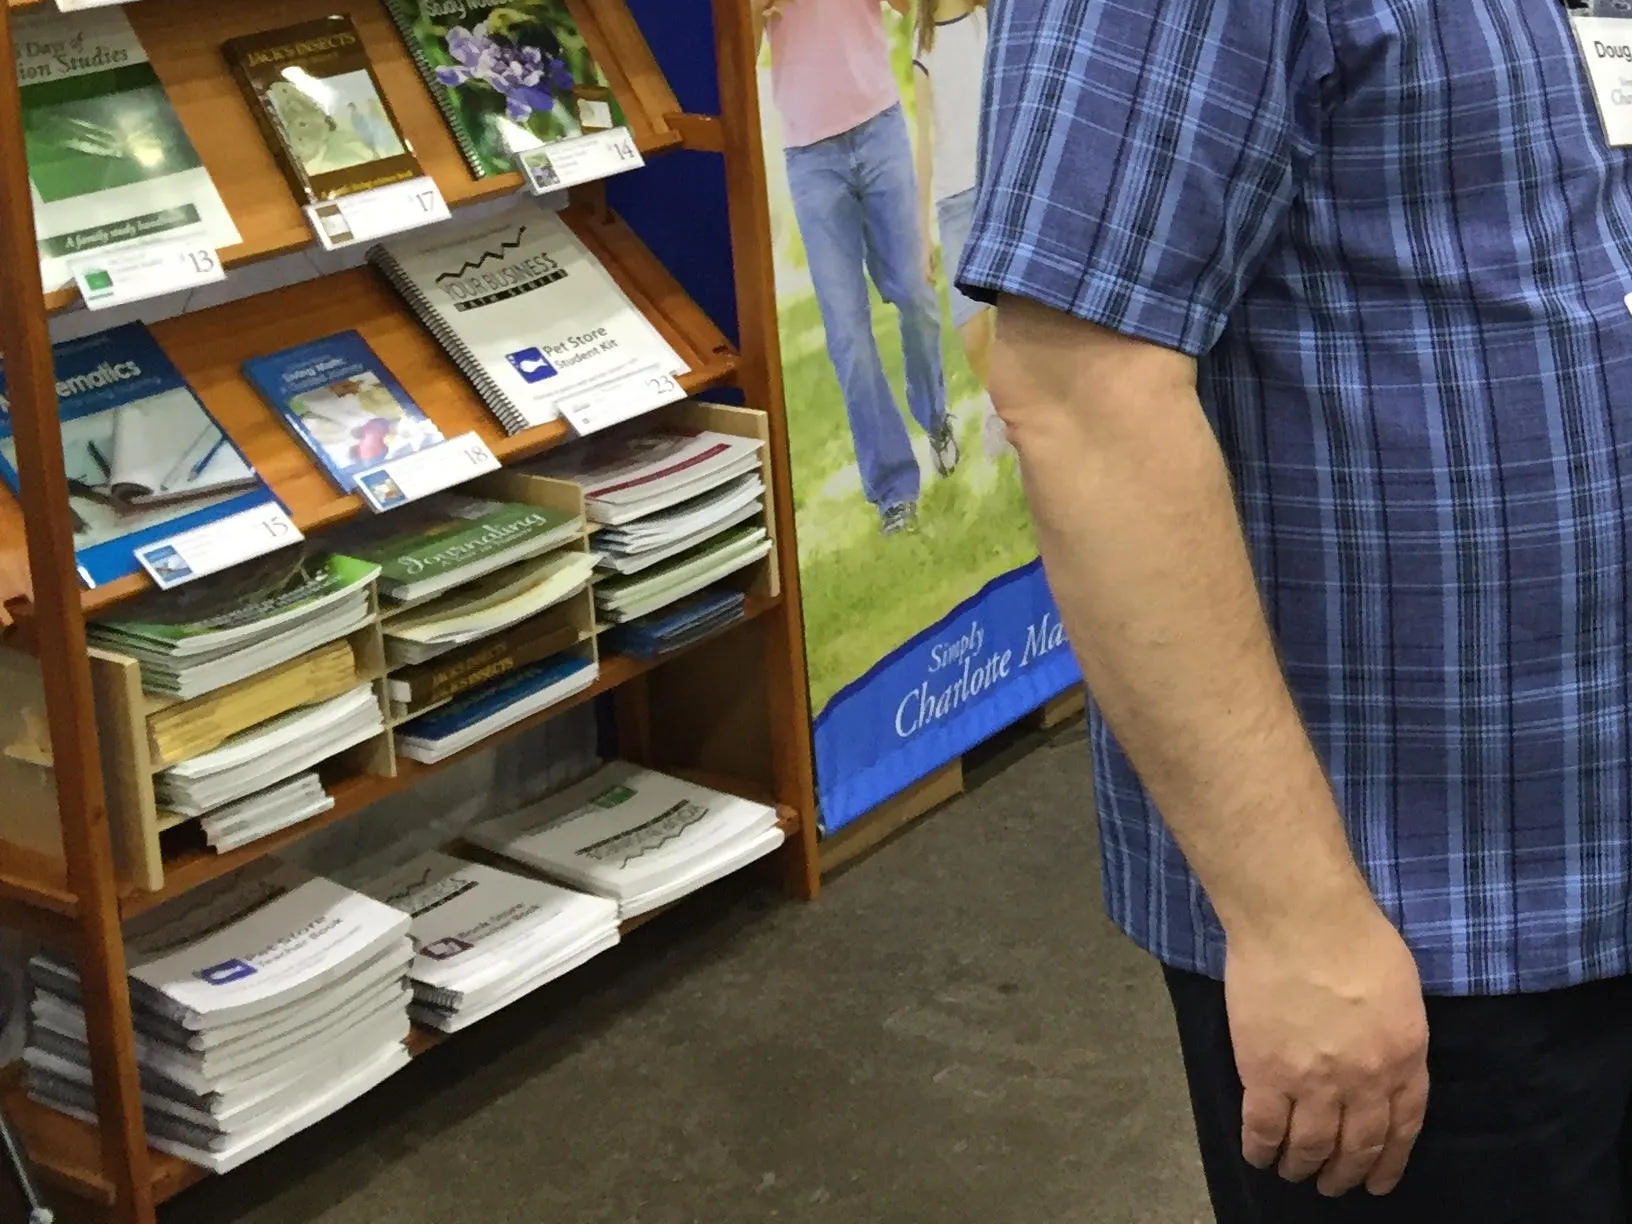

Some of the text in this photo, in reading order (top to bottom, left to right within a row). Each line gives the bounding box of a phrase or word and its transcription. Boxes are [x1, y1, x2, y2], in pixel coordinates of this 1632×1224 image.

[55, 46, 129, 74] Studies
[483, 252, 559, 290] BUSINESS
[543, 327, 608, 357] Pet Store
[553, 338, 619, 371] Student Kit
[398, 512, 548, 575] Journaling
[928, 620, 985, 673] Simply
[895, 648, 1012, 737] Charlotte
